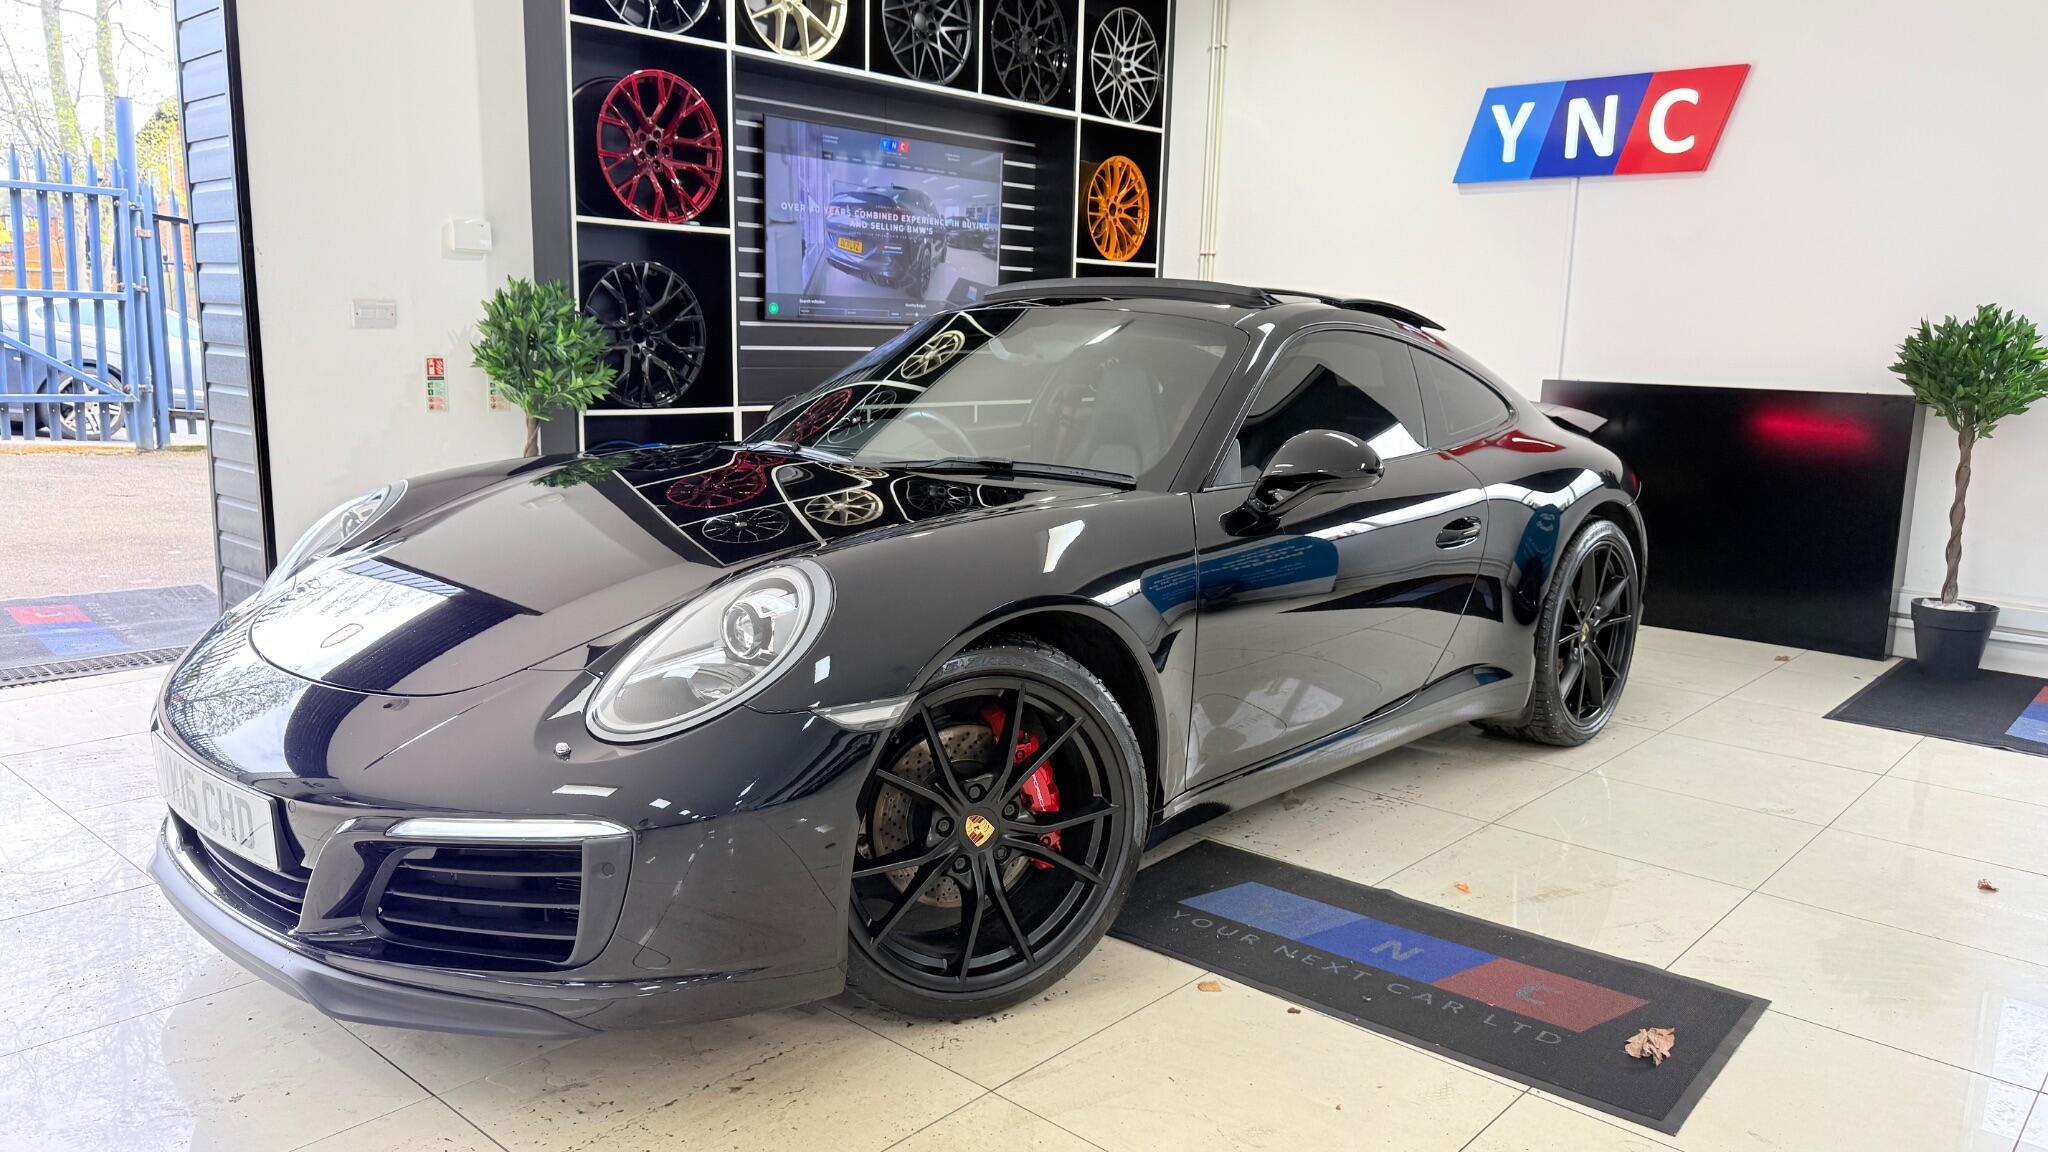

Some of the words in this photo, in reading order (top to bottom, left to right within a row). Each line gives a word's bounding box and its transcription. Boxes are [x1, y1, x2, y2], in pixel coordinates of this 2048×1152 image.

[882, 141, 906, 151] YNC
[1491, 87, 1699, 163] YNC
[780, 201, 807, 214] OVER
[824, 206, 852, 218] YEARS
[854, 209, 899, 222] COMBINED
[901, 214, 950, 228] EXPERIENCE
[961, 220, 990, 232] BUYING
[849, 220, 868, 230] AND
[870, 221, 905, 233] SELLING
[906, 225, 934, 236] BMW'S
[201, 779, 256, 850] CHD
[1172, 909, 1261, 946] YOUR
[1273, 944, 1372, 981] NEXT
[1386, 982, 1465, 1015] CAR
[1483, 1013, 1563, 1044] LTD
